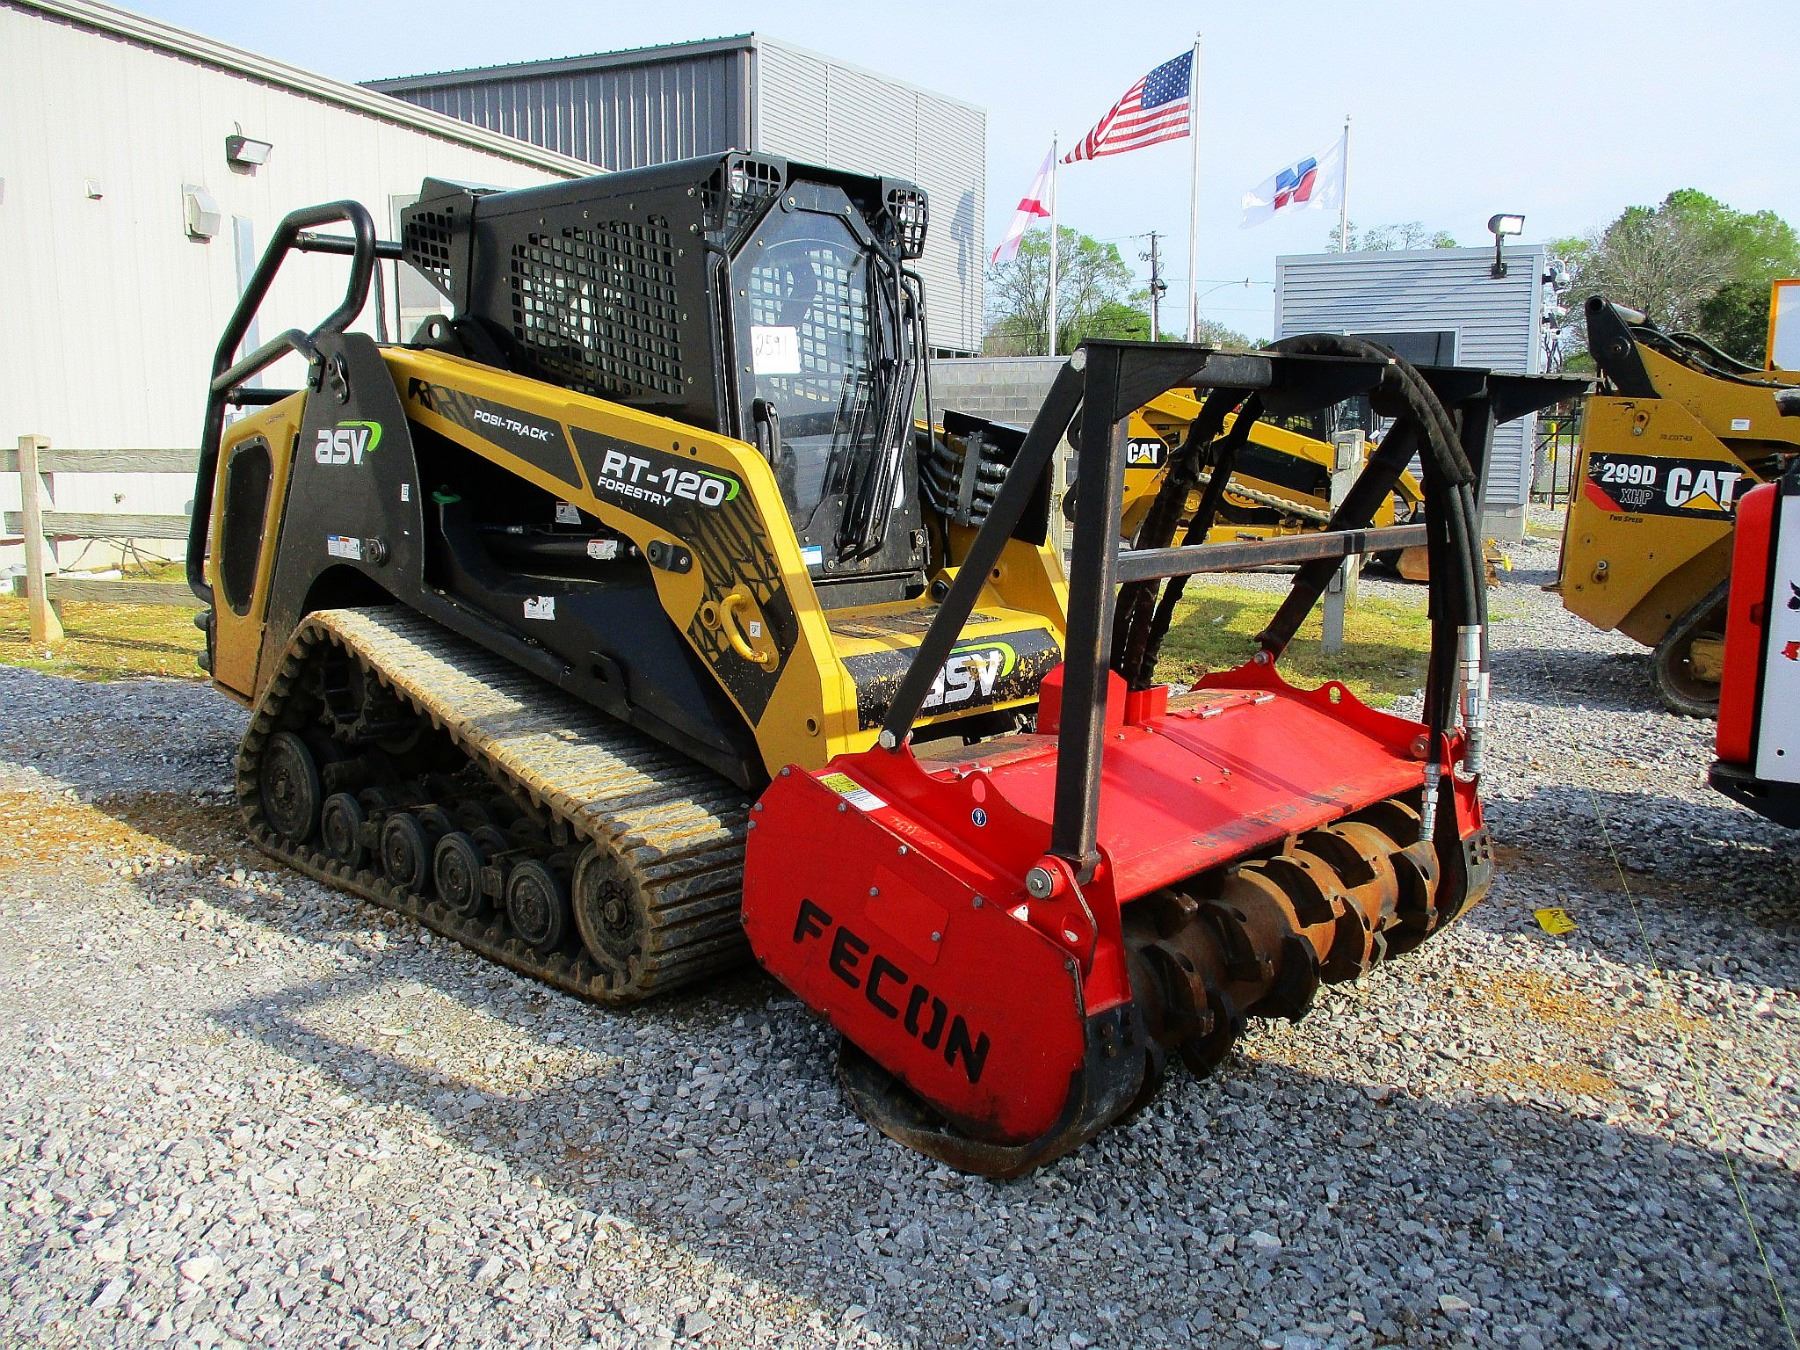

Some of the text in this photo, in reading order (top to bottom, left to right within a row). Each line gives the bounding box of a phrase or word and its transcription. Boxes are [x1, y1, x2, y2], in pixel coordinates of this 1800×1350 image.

[473, 409, 549, 442] POSI-TRACK
[1127, 442, 1160, 465] CAT
[601, 450, 725, 506] RT-120
[1601, 462, 1656, 485] 299D
[597, 477, 672, 507] FORESTRY
[1619, 488, 1653, 505] XHP
[1665, 467, 1742, 512] CAT
[793, 898, 991, 1085] FECON
